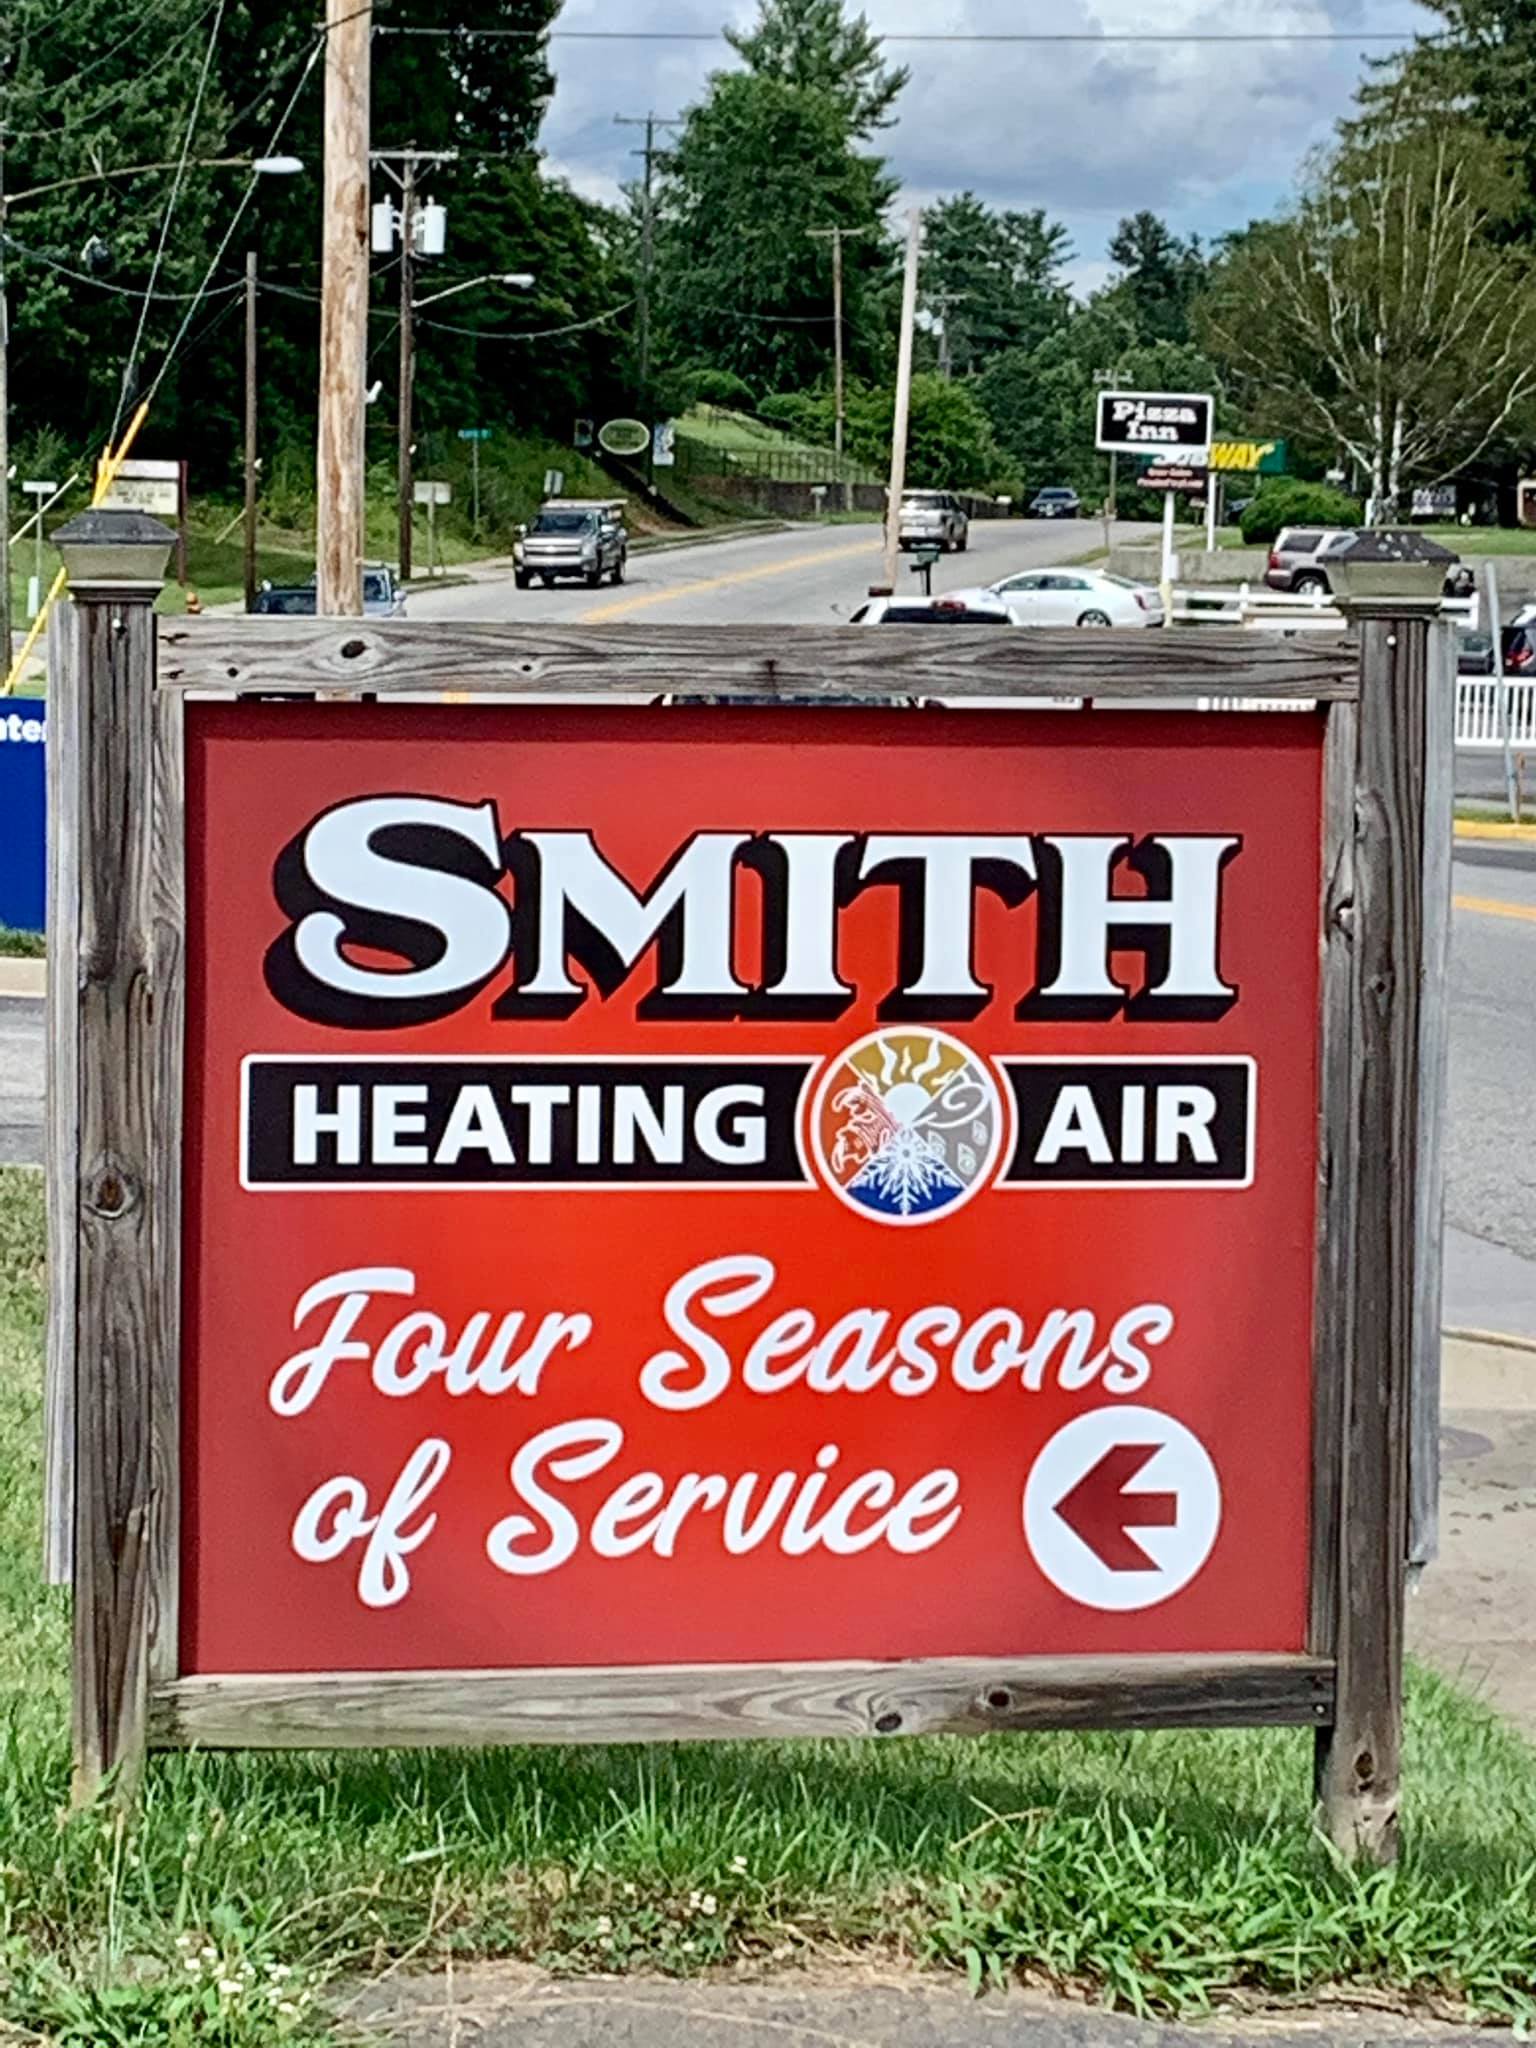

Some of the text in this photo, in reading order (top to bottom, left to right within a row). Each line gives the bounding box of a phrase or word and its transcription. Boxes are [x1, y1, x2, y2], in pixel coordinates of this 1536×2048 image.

[1112, 400, 1197, 424] Pizza
[1126, 420, 1178, 441] Inn
[292, 796, 1240, 1000] SMITH
[293, 1084, 1218, 1166] HEATING AIR
[269, 1254, 1174, 1416] Four Seasons
[292, 1417, 962, 1608] of Service
